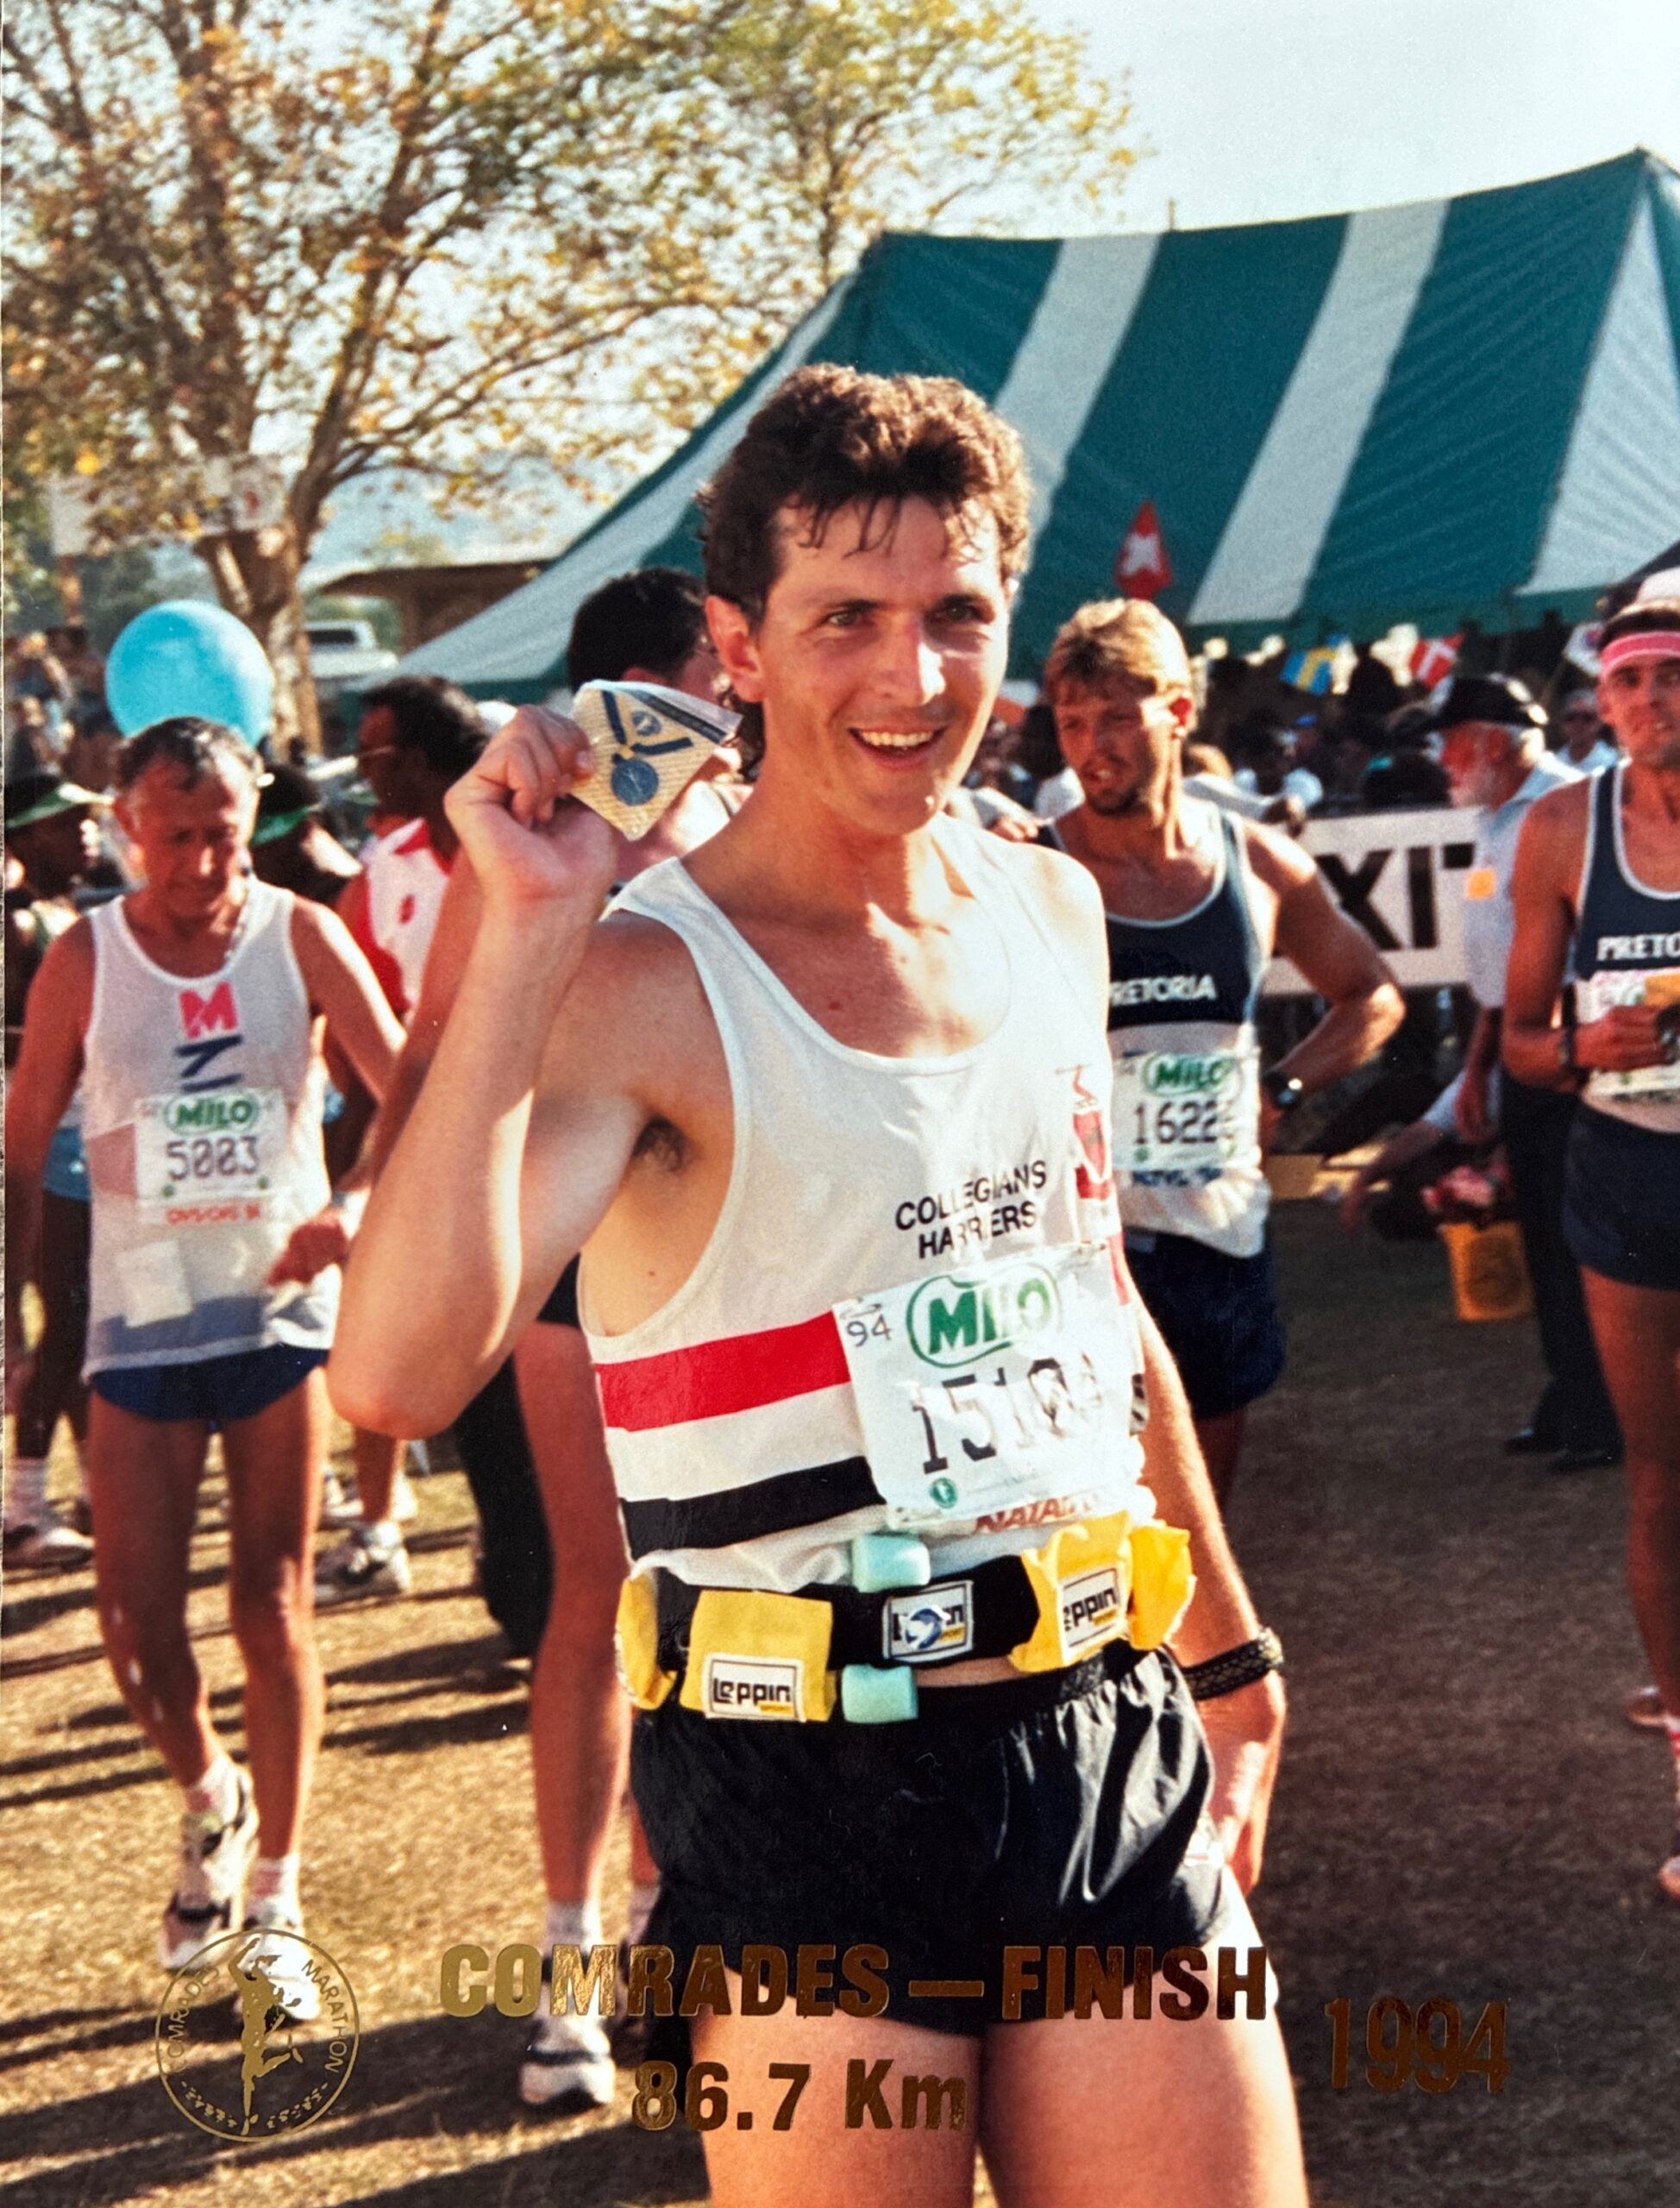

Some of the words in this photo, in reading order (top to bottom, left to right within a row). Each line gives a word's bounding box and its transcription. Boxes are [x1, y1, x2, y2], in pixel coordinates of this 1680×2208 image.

[1314, 842, 1476, 950] XI
[1110, 975, 1217, 1007] RETORIA
[176, 1100, 254, 1129] MILO
[1132, 1099, 1236, 1145] 1622
[846, 1314, 892, 1347] 94
[975, 1496, 1083, 1533] NATA
[1062, 1587, 1118, 1632] eppin
[712, 1678, 791, 1706] Leppin
